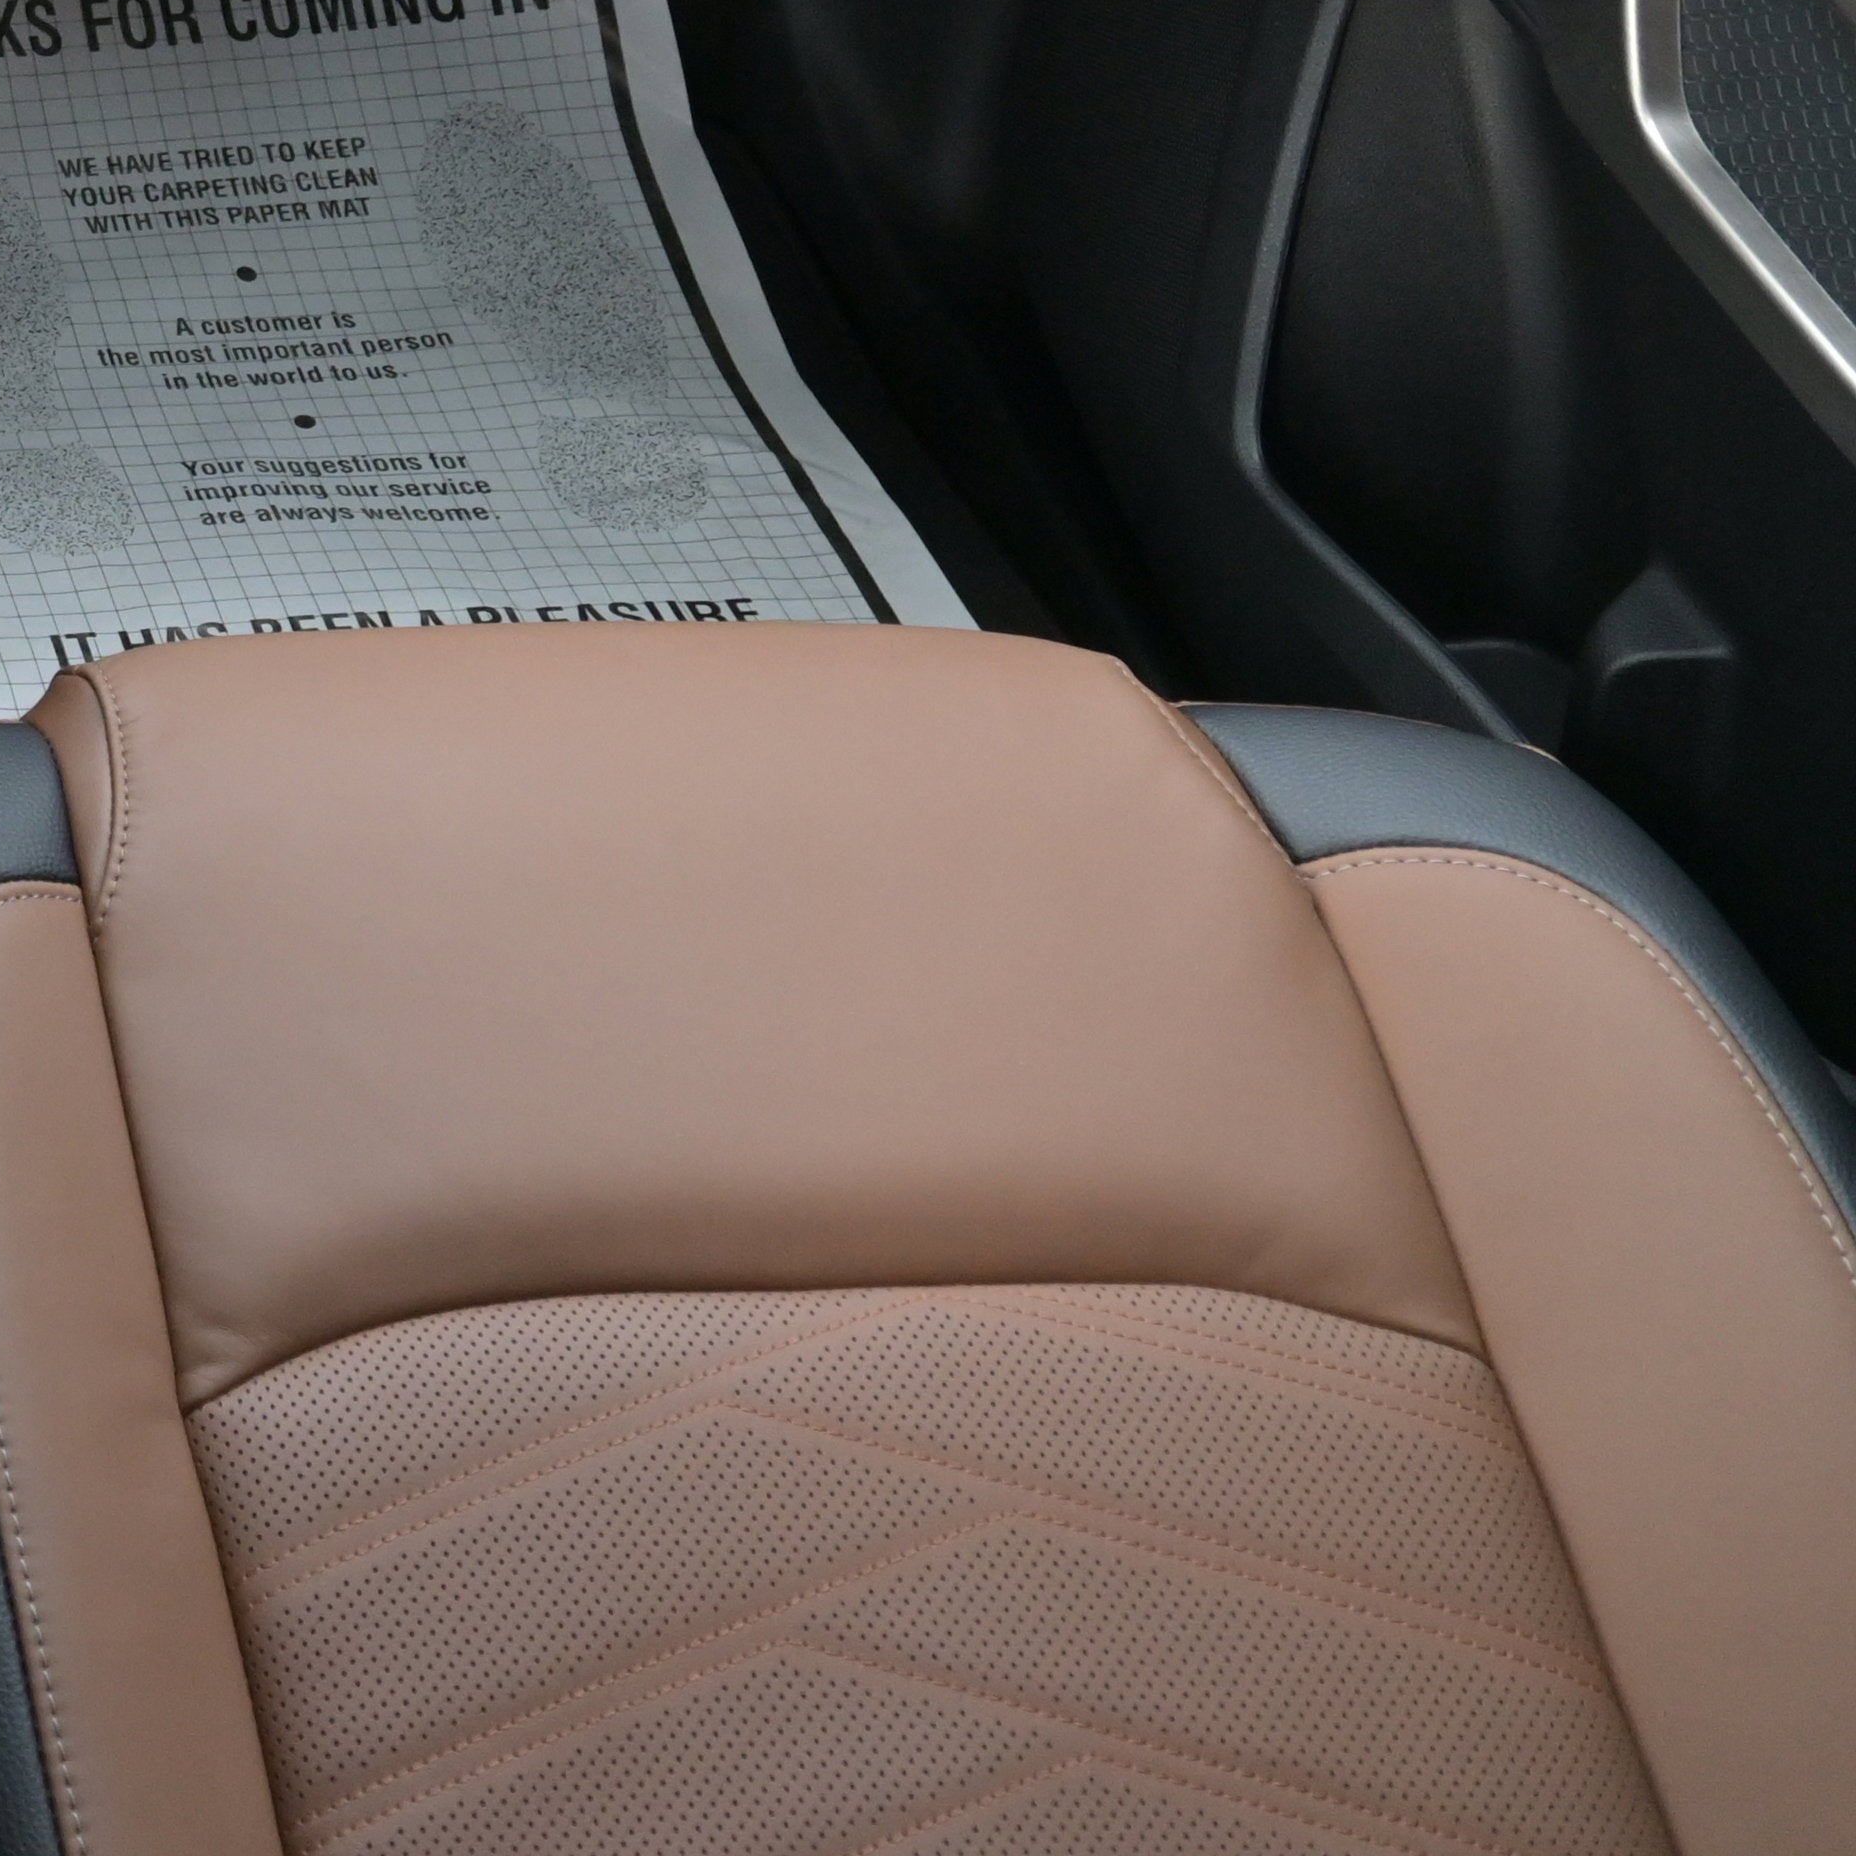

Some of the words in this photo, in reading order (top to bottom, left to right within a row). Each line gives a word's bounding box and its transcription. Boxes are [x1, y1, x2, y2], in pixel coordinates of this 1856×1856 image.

[57, 157, 98, 179] WE
[105, 151, 173, 175] HAVE
[178, 145, 255, 170] TRIED
[260, 142, 296, 164] TO
[303, 136, 366, 161] KEEP
[61, 185, 135, 208] YOUR
[143, 174, 288, 204] CARPETING
[295, 166, 378, 192] CLEAN
[84, 212, 153, 235] WITH
[159, 206, 220, 229] THIS
[227, 200, 311, 225] PAPER
[318, 197, 371, 220] MAT
[175, 317, 193, 336] A
[201, 313, 322, 335] customer
[332, 311, 357, 329] is
[98, 348, 140, 367] the
[150, 344, 216, 365] most
[223, 338, 354, 363] important
[361, 331, 454, 356] person
[163, 373, 188, 390] in
[196, 371, 239, 389] the
[247, 367, 323, 386] world
[330, 365, 357, 382] to
[367, 362, 408, 380] us.
[182, 458, 244, 477] Your
[256, 453, 422, 477] suggestions
[429, 452, 467, 471] for
[183, 481, 328, 503] improving
[335, 482, 379, 499] our
[388, 478, 491, 497] service
[200, 508, 246, 527] are
[257, 502, 354, 524] always
[362, 504, 500, 522] welcome.
